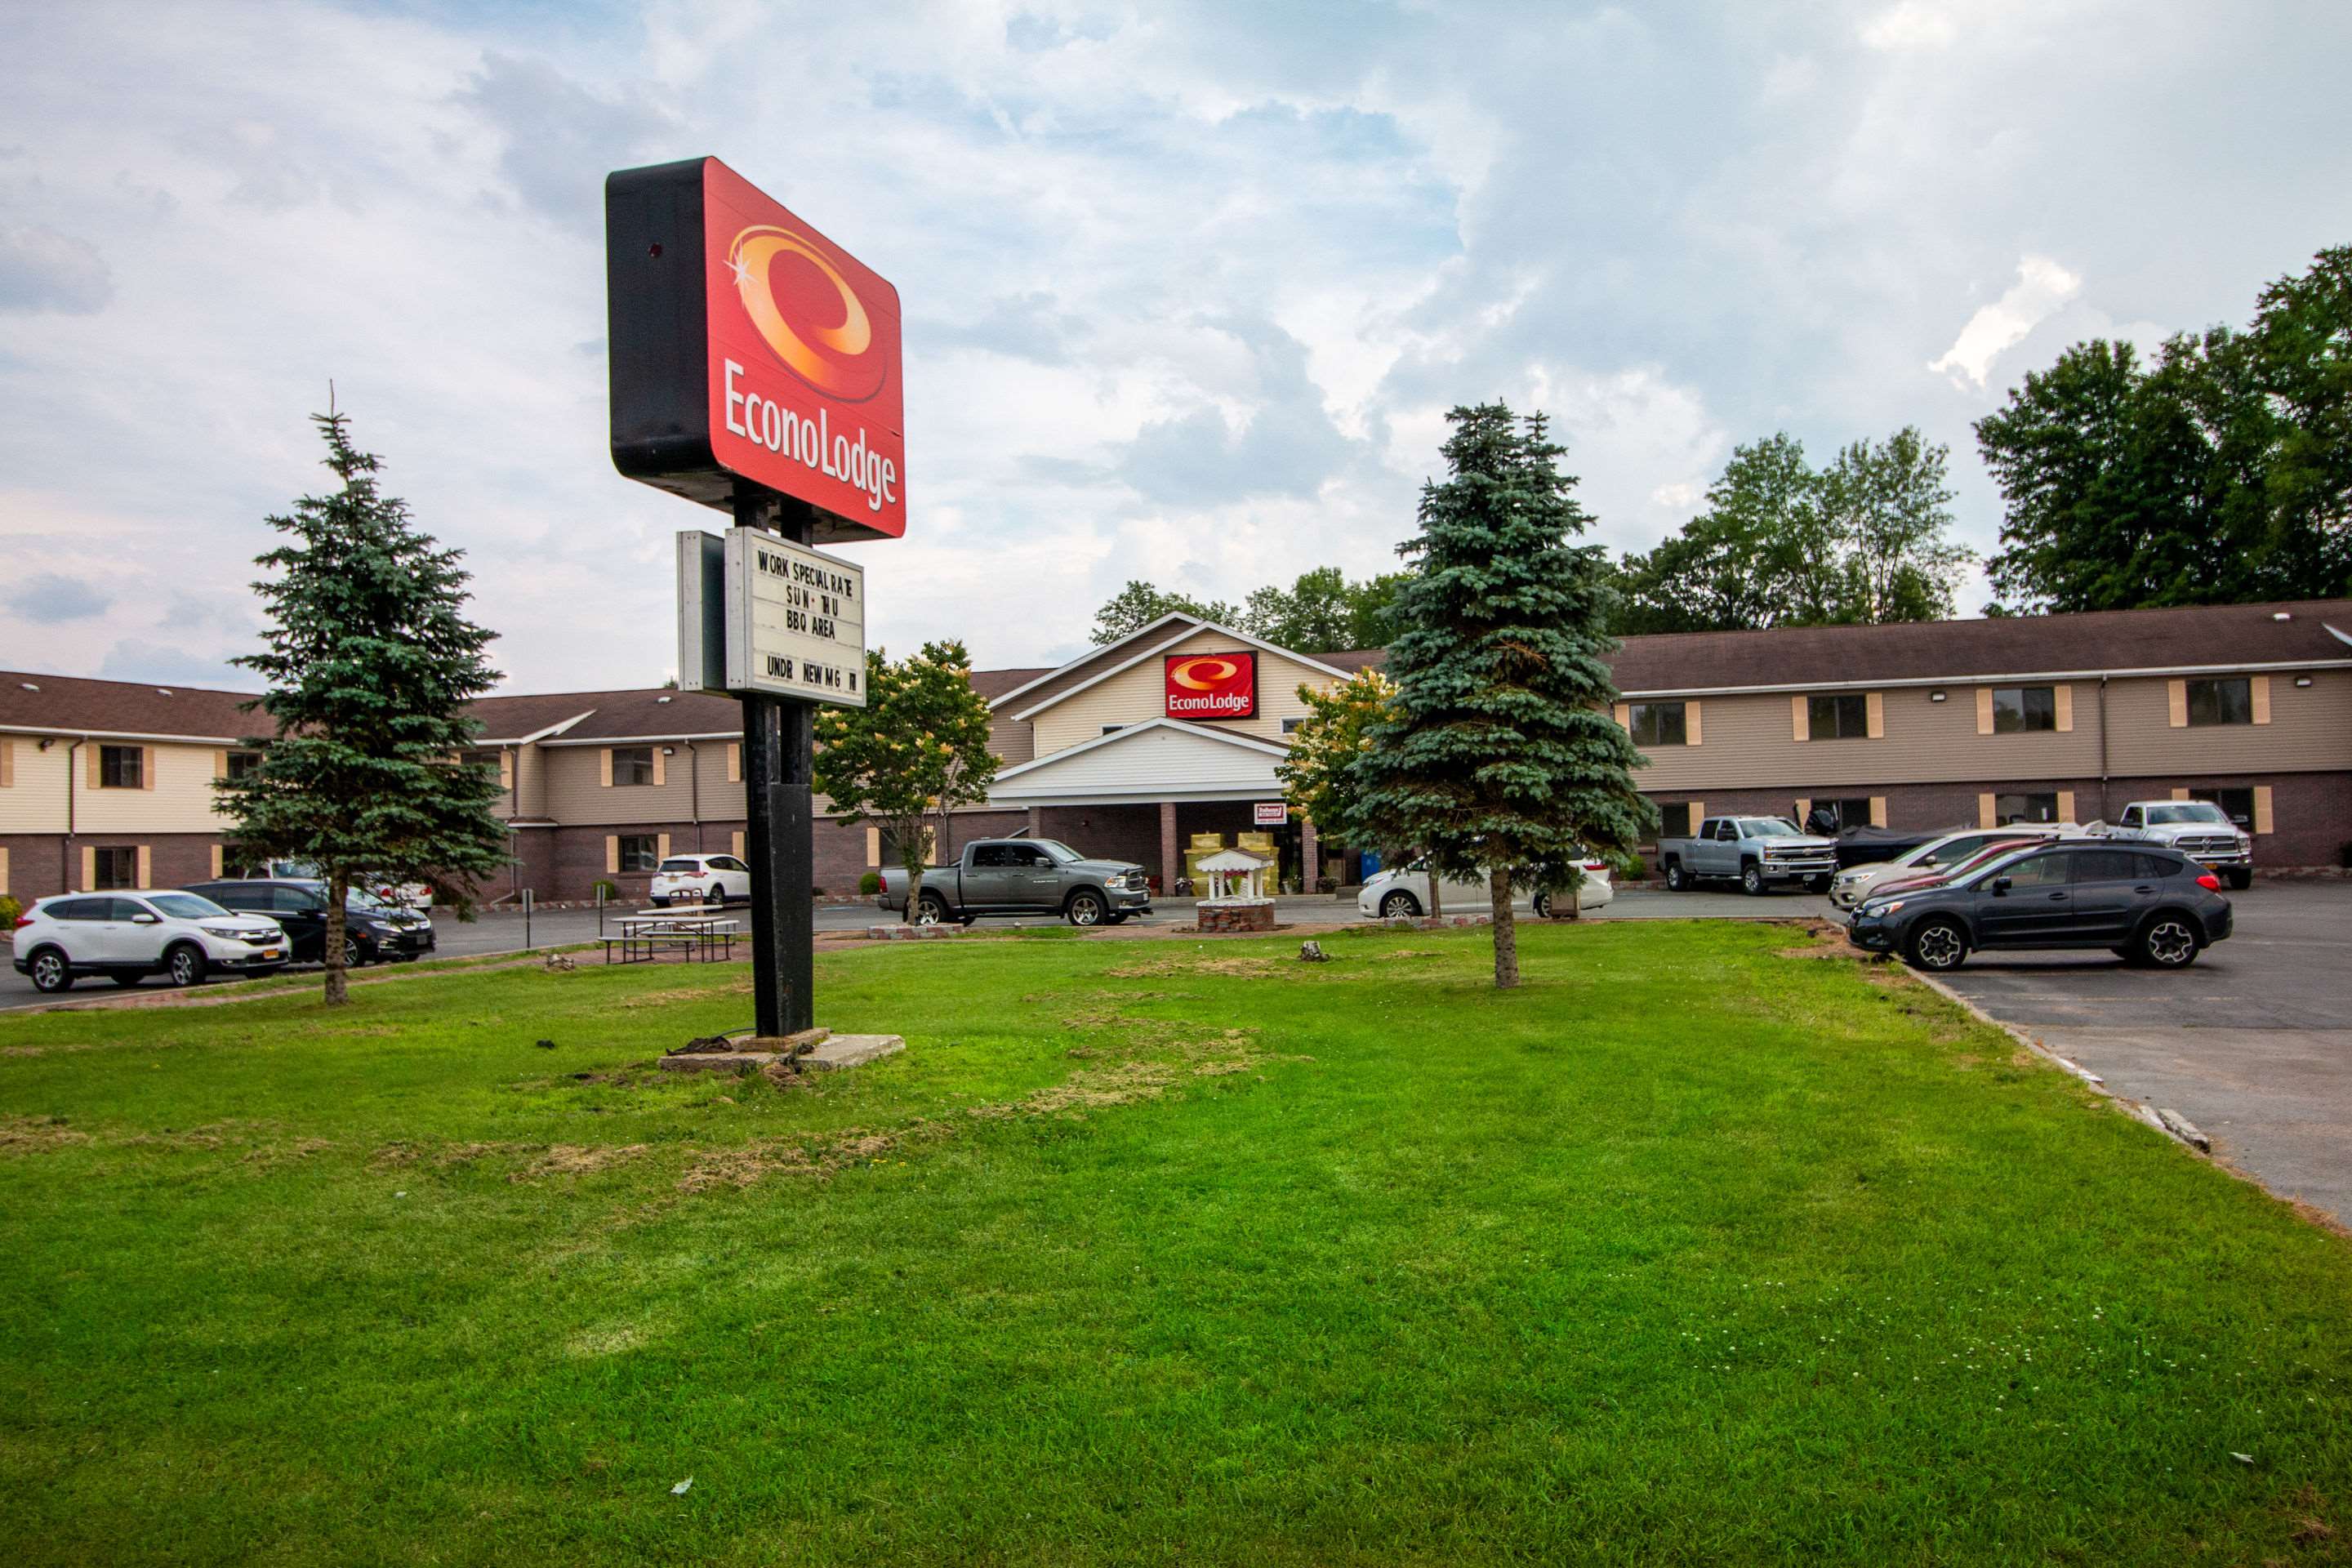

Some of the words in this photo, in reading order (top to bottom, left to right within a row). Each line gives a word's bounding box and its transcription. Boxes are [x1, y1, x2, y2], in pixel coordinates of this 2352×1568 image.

[724, 358, 896, 511] EconoLodge
[758, 550, 789, 578] WORK
[793, 563, 828, 590] SPECIAL
[831, 574, 853, 597] RATE
[786, 585, 809, 608] SUN
[821, 595, 838, 617] THU
[786, 609, 806, 632] BBQ
[812, 617, 835, 639] AREA
[803, 662, 822, 684] NEW
[1169, 693, 1249, 711] EconoLodge
